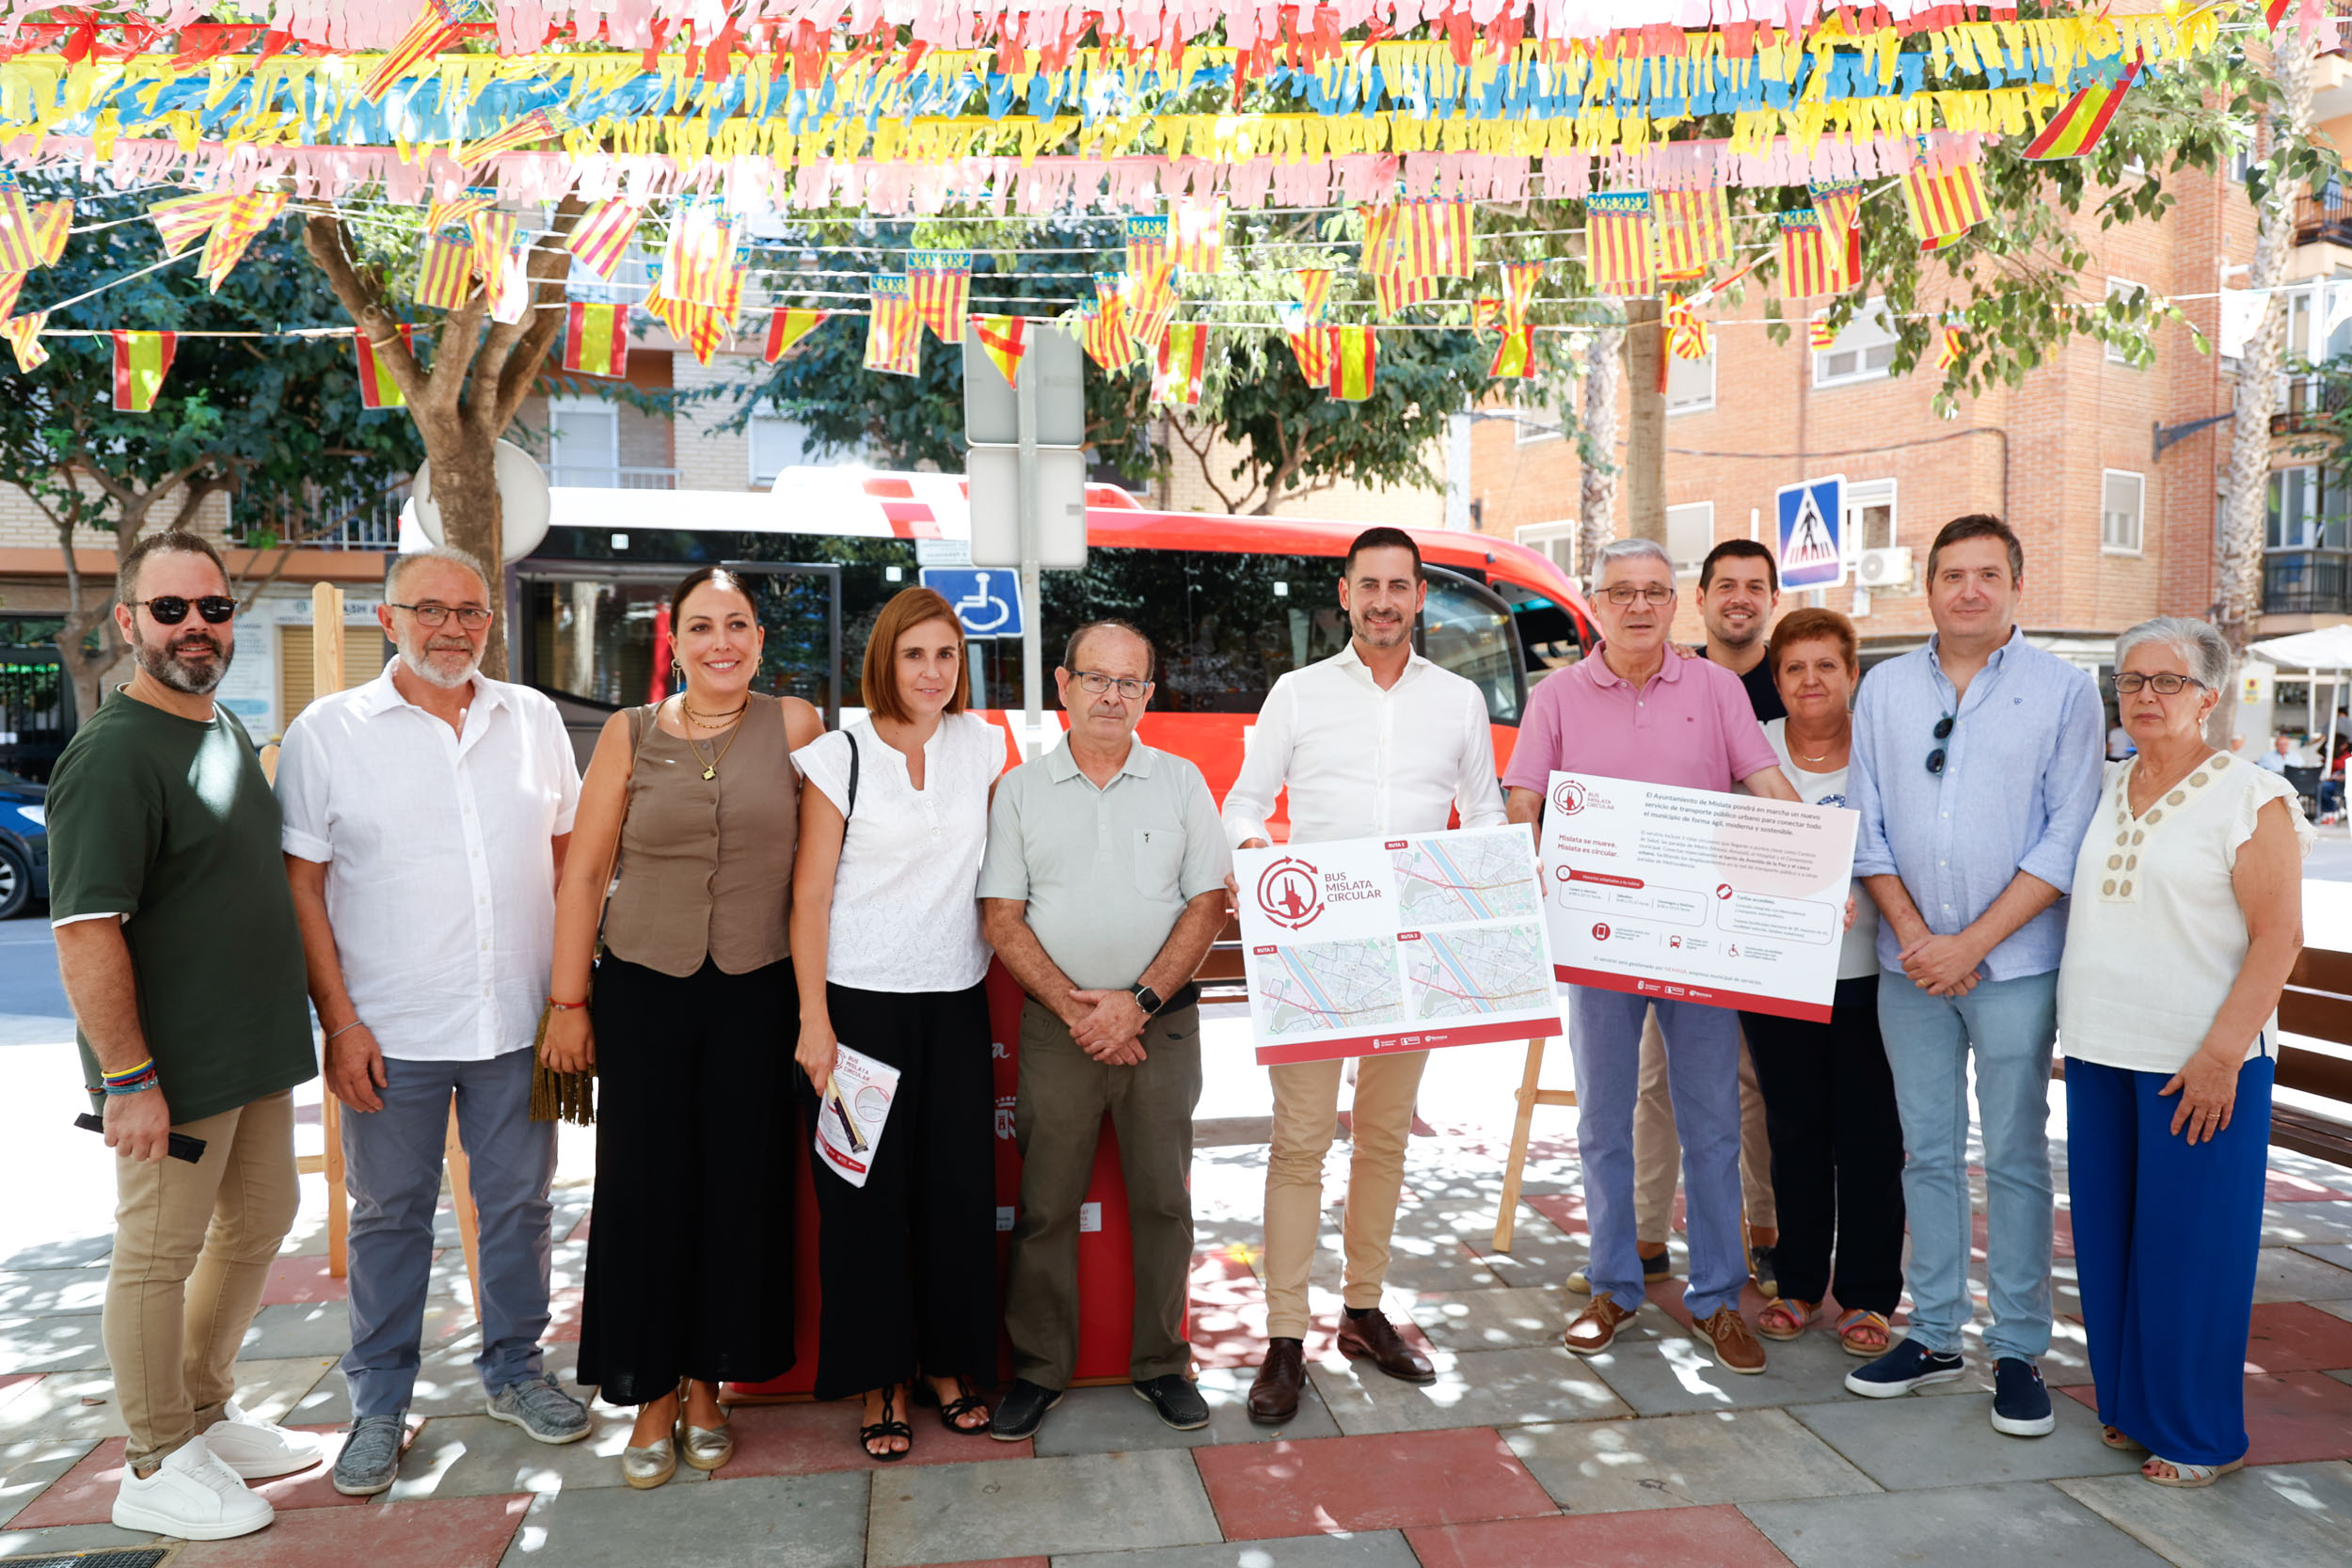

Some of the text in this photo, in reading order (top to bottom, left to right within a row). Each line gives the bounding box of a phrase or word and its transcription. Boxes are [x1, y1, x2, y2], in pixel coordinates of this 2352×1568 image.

[1654, 793, 1698, 805] Ayuntamiento
[1733, 803, 1756, 812] pondrá
[1767, 808, 1789, 816] marcha
[1645, 801, 1669, 810] servicio
[1680, 806, 1712, 816] transporte
[1714, 811, 1737, 819] público
[1778, 819, 1804, 828] conectar
[1651, 812, 1681, 821] municipio
[1725, 822, 1754, 831] moderna
[1761, 826, 1795, 836] sostenible.
[1559, 834, 1582, 843] Mislata
[1558, 844, 1581, 852] Mislata
[1592, 847, 1619, 858] circular.
[1325, 872, 1347, 882] BUS
[1326, 880, 1374, 893] MISLATA
[1327, 889, 1382, 903] CIRCULAR
[844, 1067, 871, 1082] CIRCULAR
[846, 1062, 870, 1075] MISLATA
